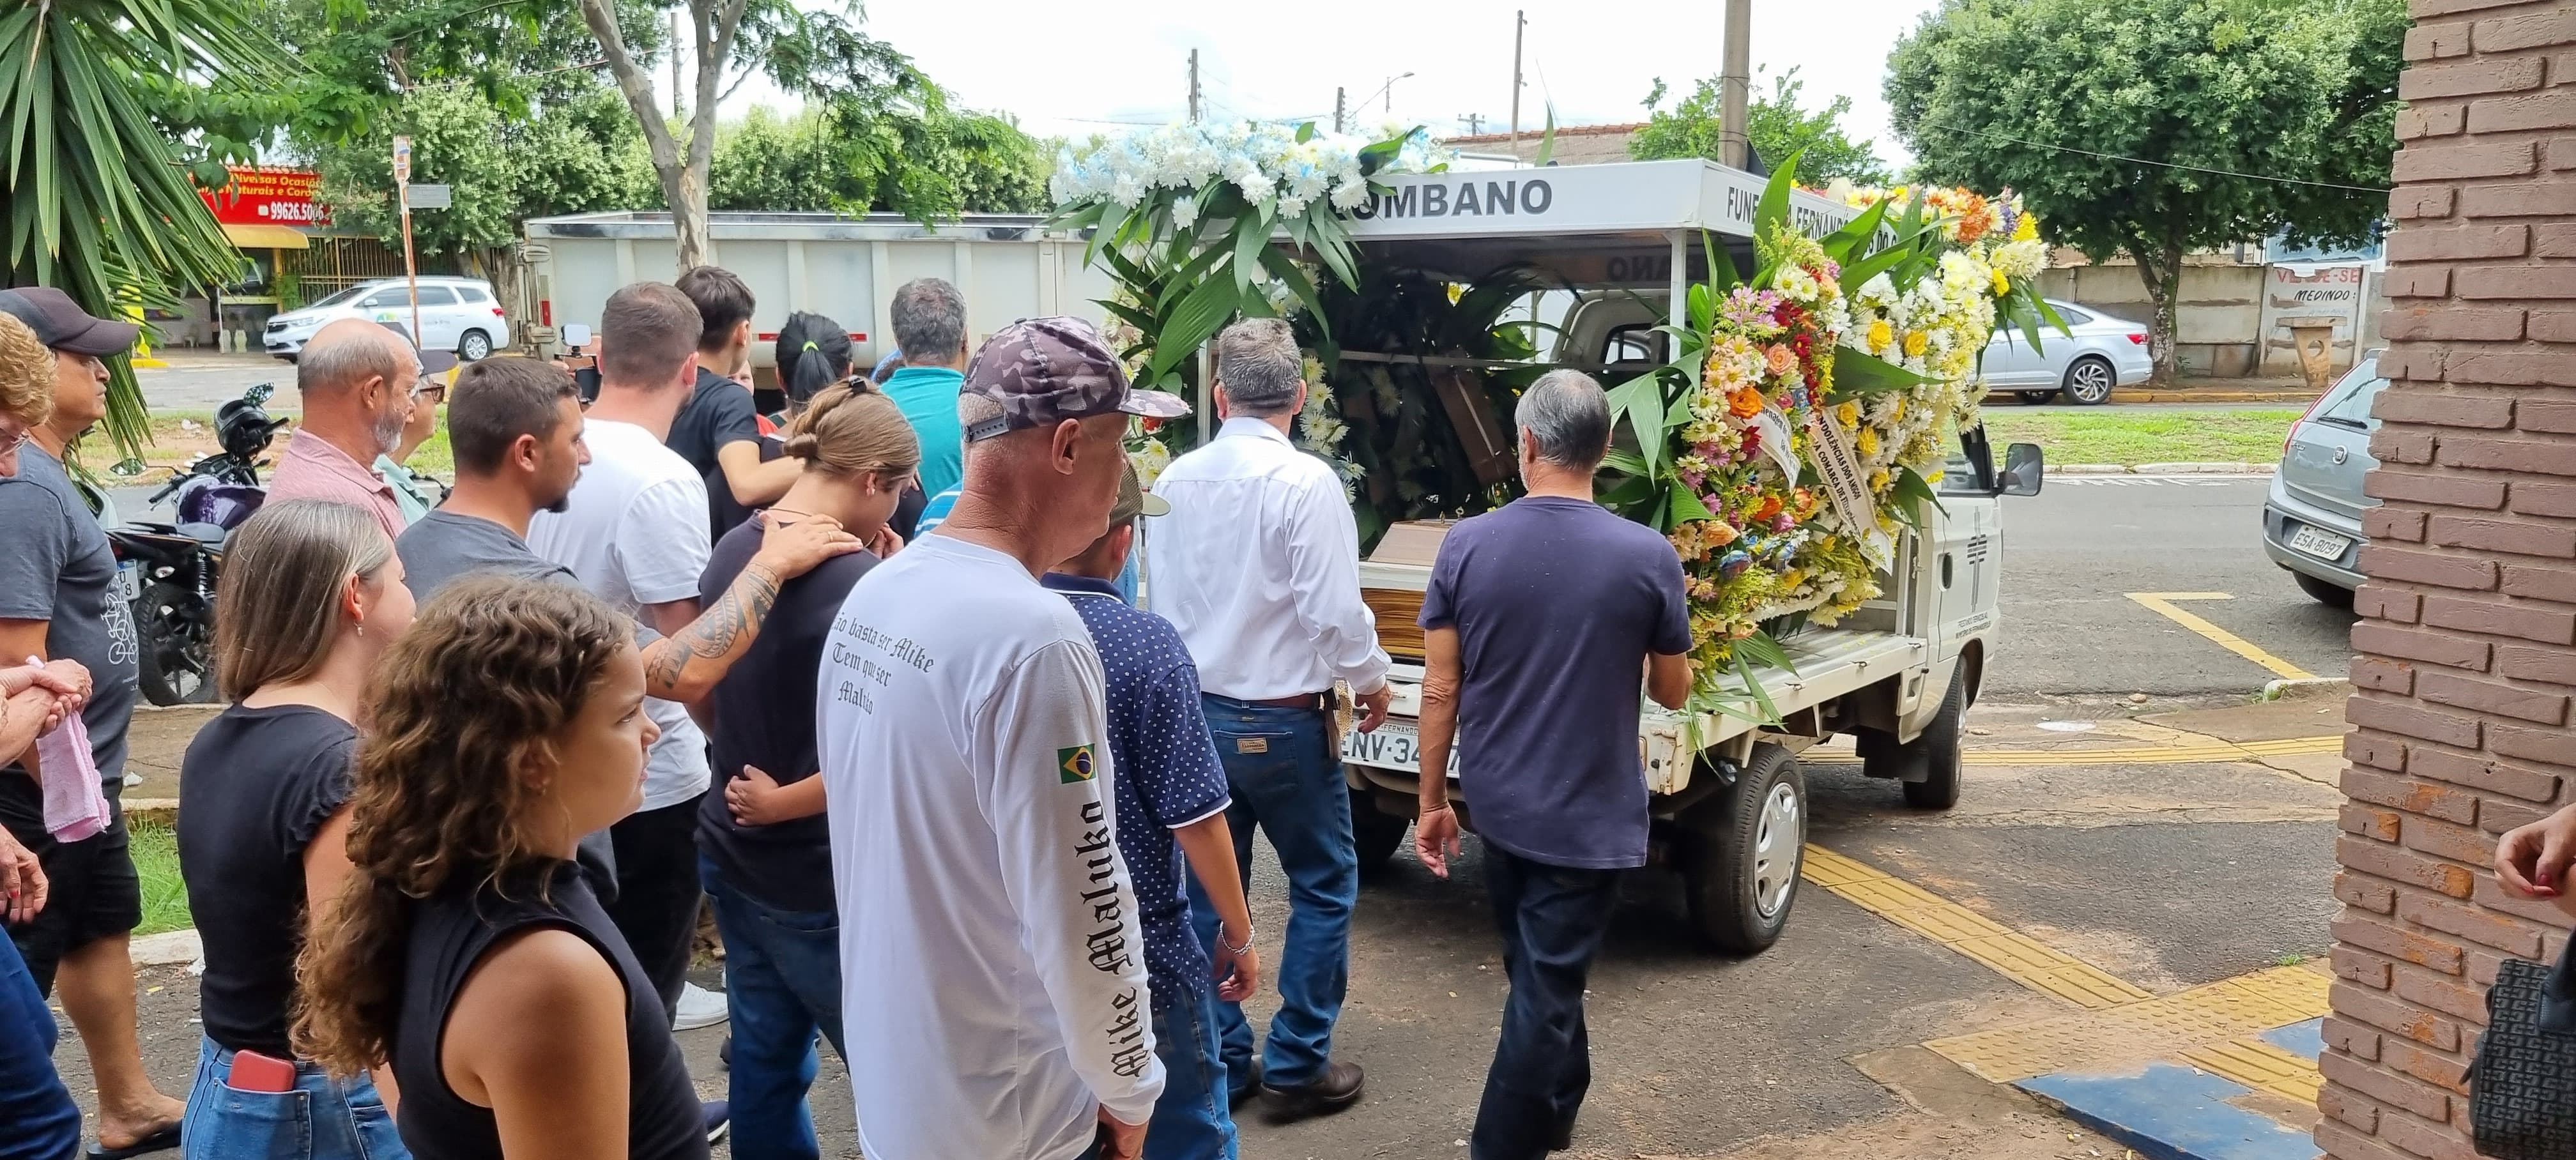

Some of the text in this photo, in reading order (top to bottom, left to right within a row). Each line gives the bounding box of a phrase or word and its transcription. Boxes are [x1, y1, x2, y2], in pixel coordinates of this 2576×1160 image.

[287, 187, 317, 197] Coro
[1818, 451, 1840, 487] COMARCA
[1837, 484, 1846, 499] DE
[1820, 416, 1846, 468] NDOLÊNCIAS
[1843, 462, 1853, 480] DOS
[831, 612, 847, 632] ão
[848, 617, 878, 646] basta
[889, 637, 934, 673] Mike
[833, 642, 861, 671] Tem
[875, 665, 892, 687] ser
[1074, 800, 1151, 1078] Mike Maluko
